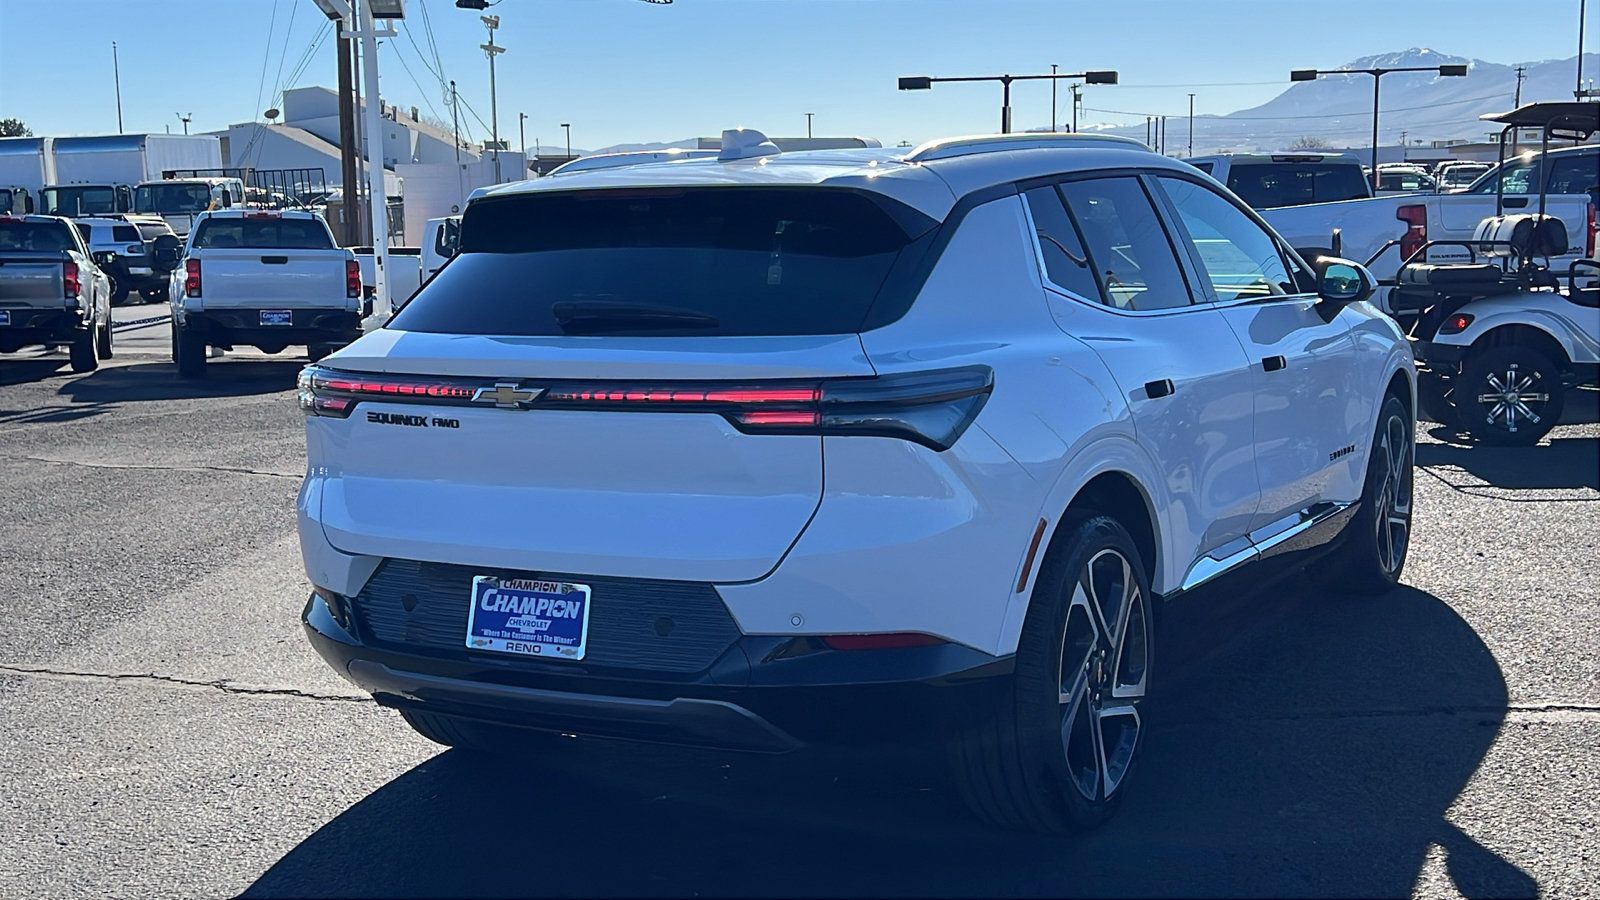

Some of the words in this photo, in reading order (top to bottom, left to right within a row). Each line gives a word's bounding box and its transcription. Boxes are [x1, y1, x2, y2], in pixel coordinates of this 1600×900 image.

[367, 412, 429, 427] EQUINOX
[432, 418, 459, 428] AWD
[504, 579, 558, 592] CHAMPION
[481, 589, 580, 619] CHAMPION
[509, 618, 548, 628] CHEVROLET
[501, 630, 510, 638] The
[511, 631, 536, 641] Customer
[543, 634, 552, 642] The
[506, 642, 541, 654] RENO
